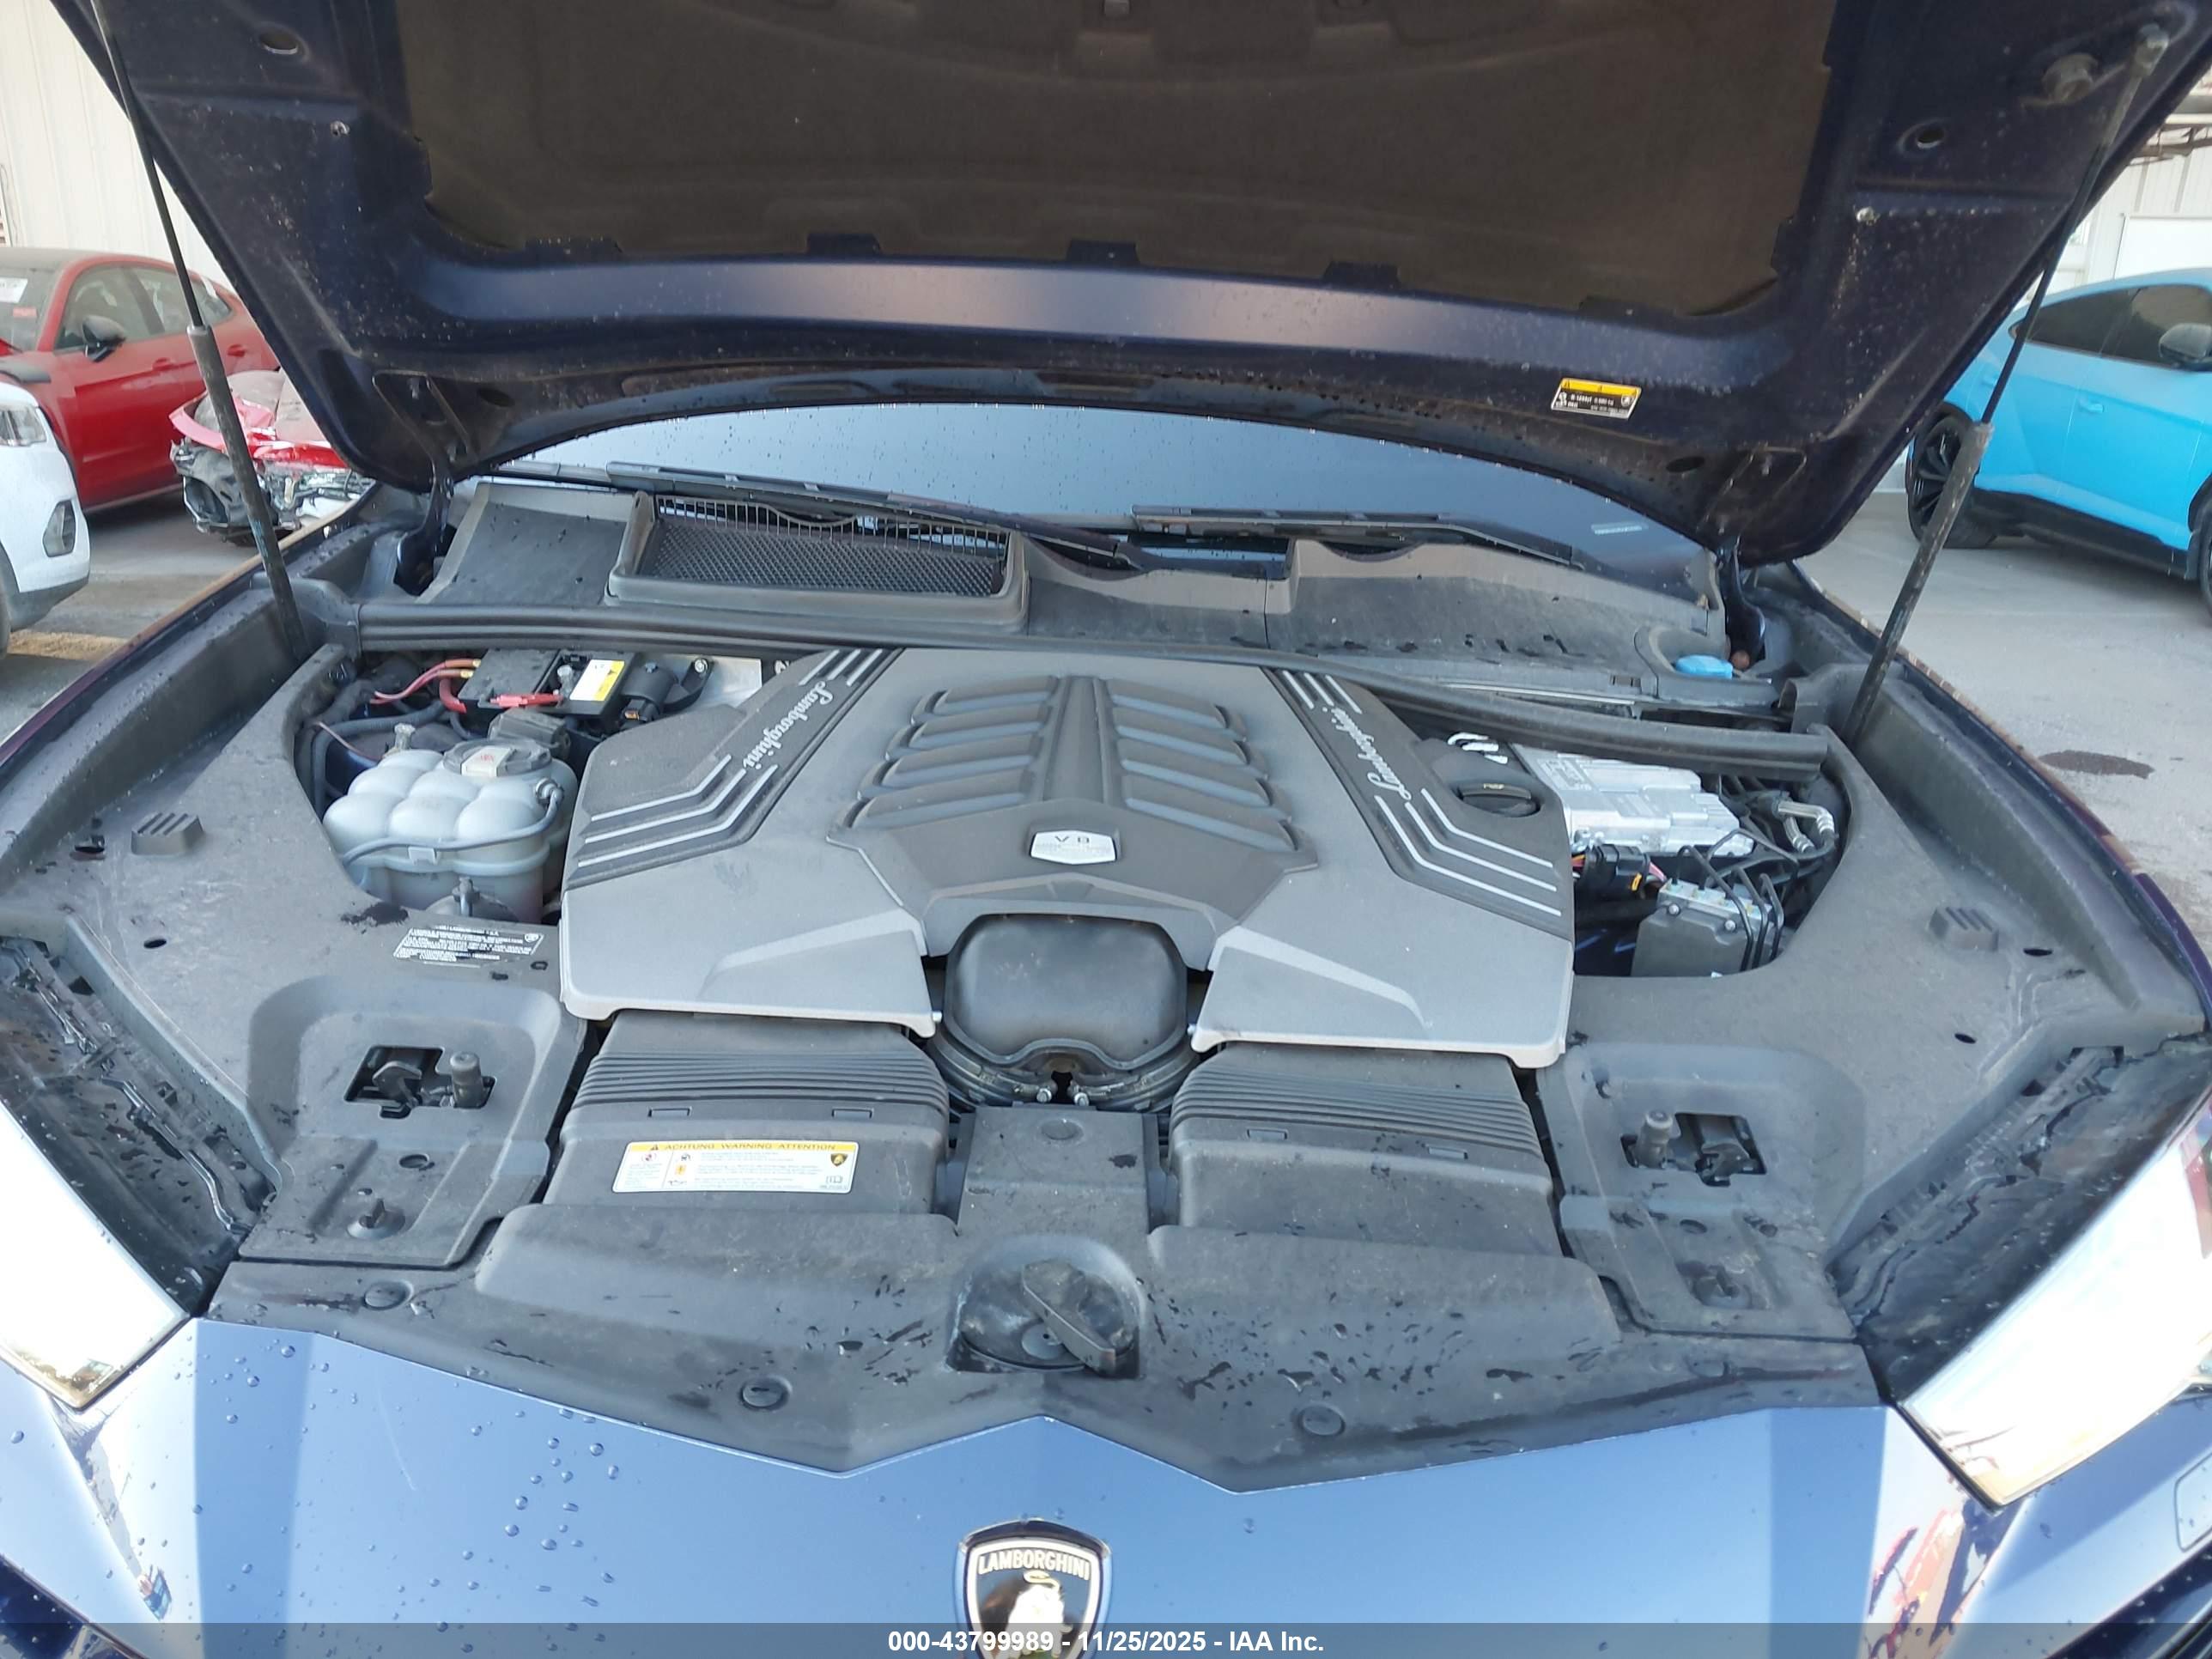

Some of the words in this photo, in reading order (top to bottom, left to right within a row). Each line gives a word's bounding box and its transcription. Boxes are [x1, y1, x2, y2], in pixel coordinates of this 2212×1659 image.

[743, 680, 833, 770] Lamborghini
[1322, 706, 1413, 800] Lamborghini
[978, 1549, 1091, 1581] LAMBORGHINI
